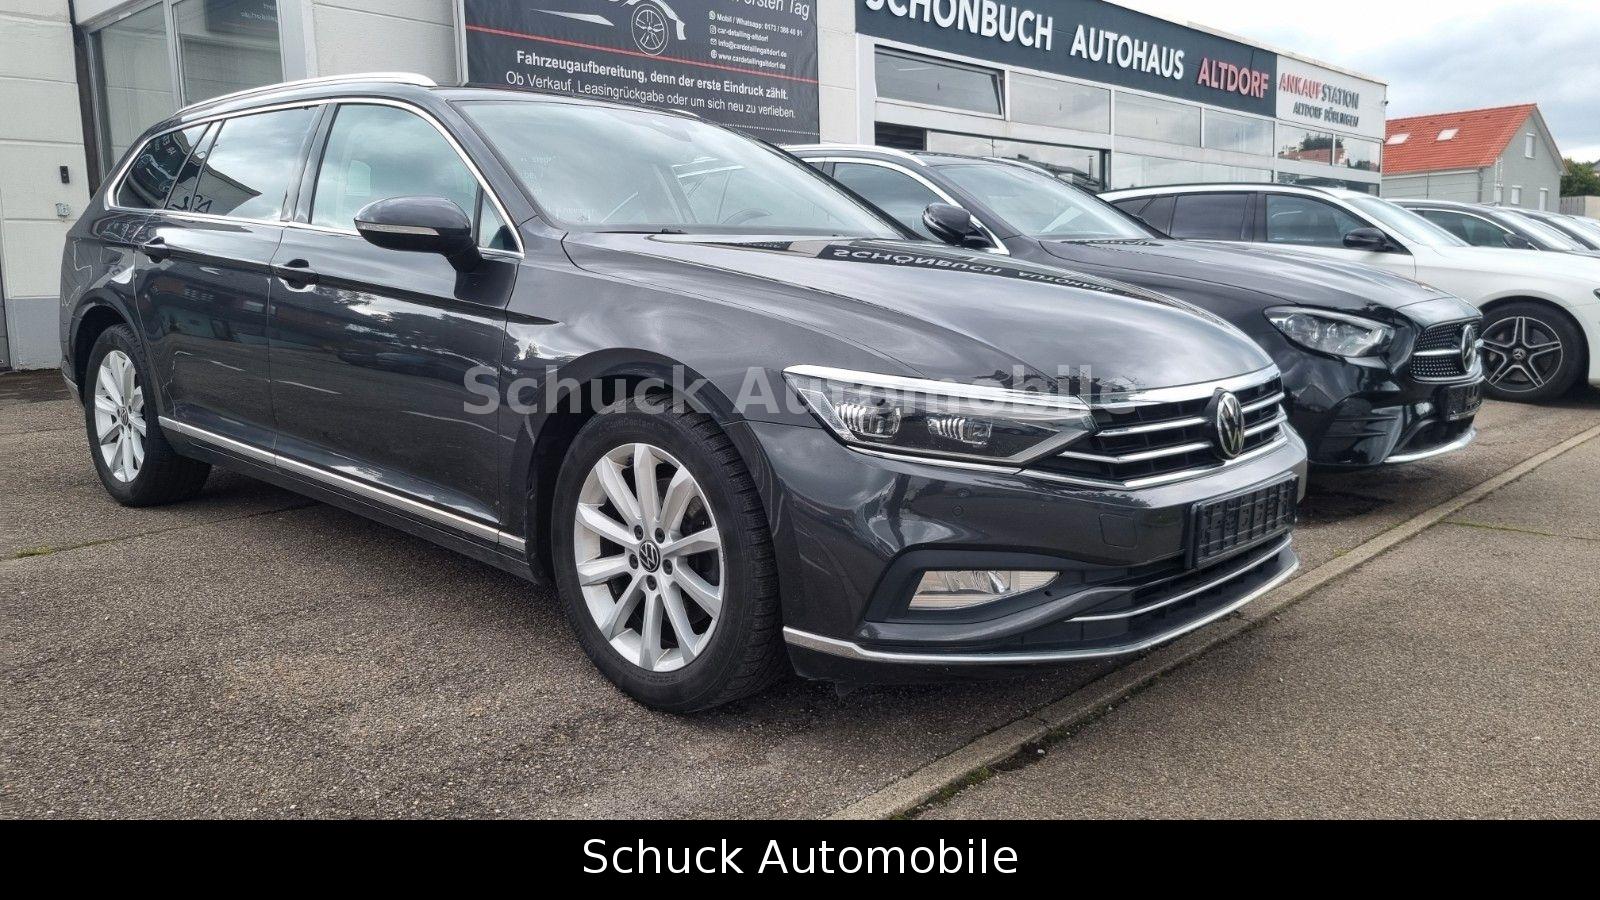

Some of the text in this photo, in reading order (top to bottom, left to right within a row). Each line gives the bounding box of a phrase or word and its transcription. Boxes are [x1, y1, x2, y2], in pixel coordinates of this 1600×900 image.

[789, 0, 810, 20] Tag
[516, 50, 788, 100] Fahrzeugaufbereitung, denn der erste Eindruck zählt.
[1070, 24, 1185, 80] AUTOHAUS
[1197, 57, 1269, 98] ALTDORF
[506, 70, 796, 119] Ob Verkauf, Leasingrückgabe oder um sich neu zu verlieben.
[1293, 102, 1322, 119] ALTDORF
